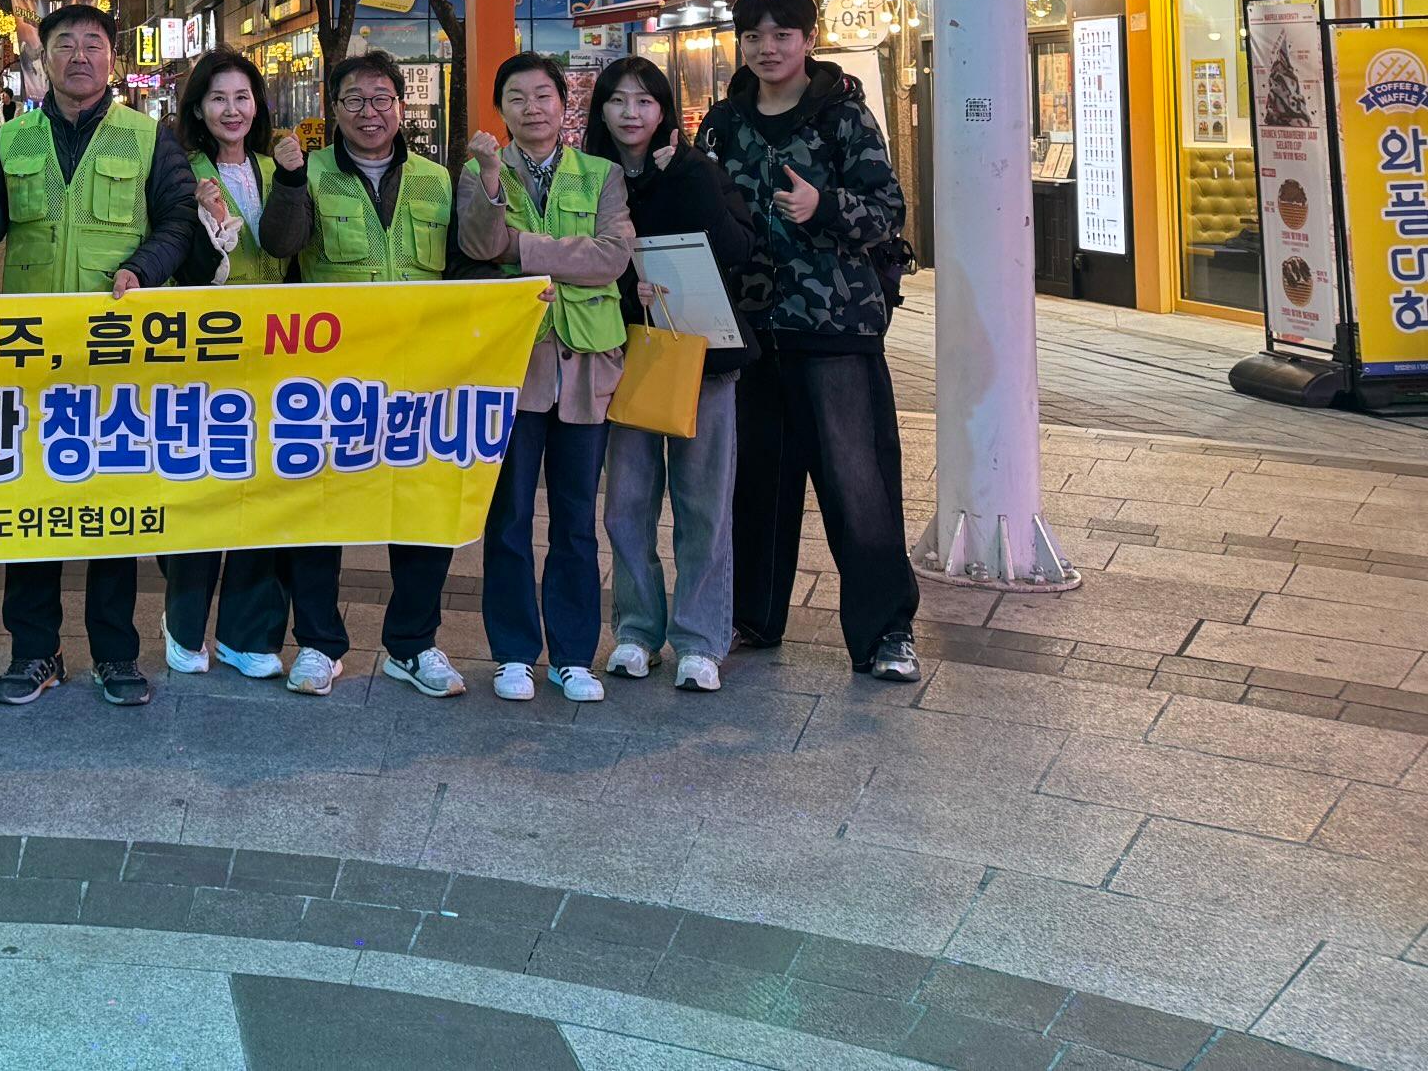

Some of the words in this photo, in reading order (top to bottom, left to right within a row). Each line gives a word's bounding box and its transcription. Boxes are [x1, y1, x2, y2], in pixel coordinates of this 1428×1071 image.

[1374, 81, 1412, 94] COFFEE
[1378, 93, 1418, 106] WAFFLE
[86, 311, 244, 367] 흡연은
[264, 312, 342, 356] NO
[39, 382, 256, 482] 청소년을
[271, 377, 521, 478] 응원합니다
